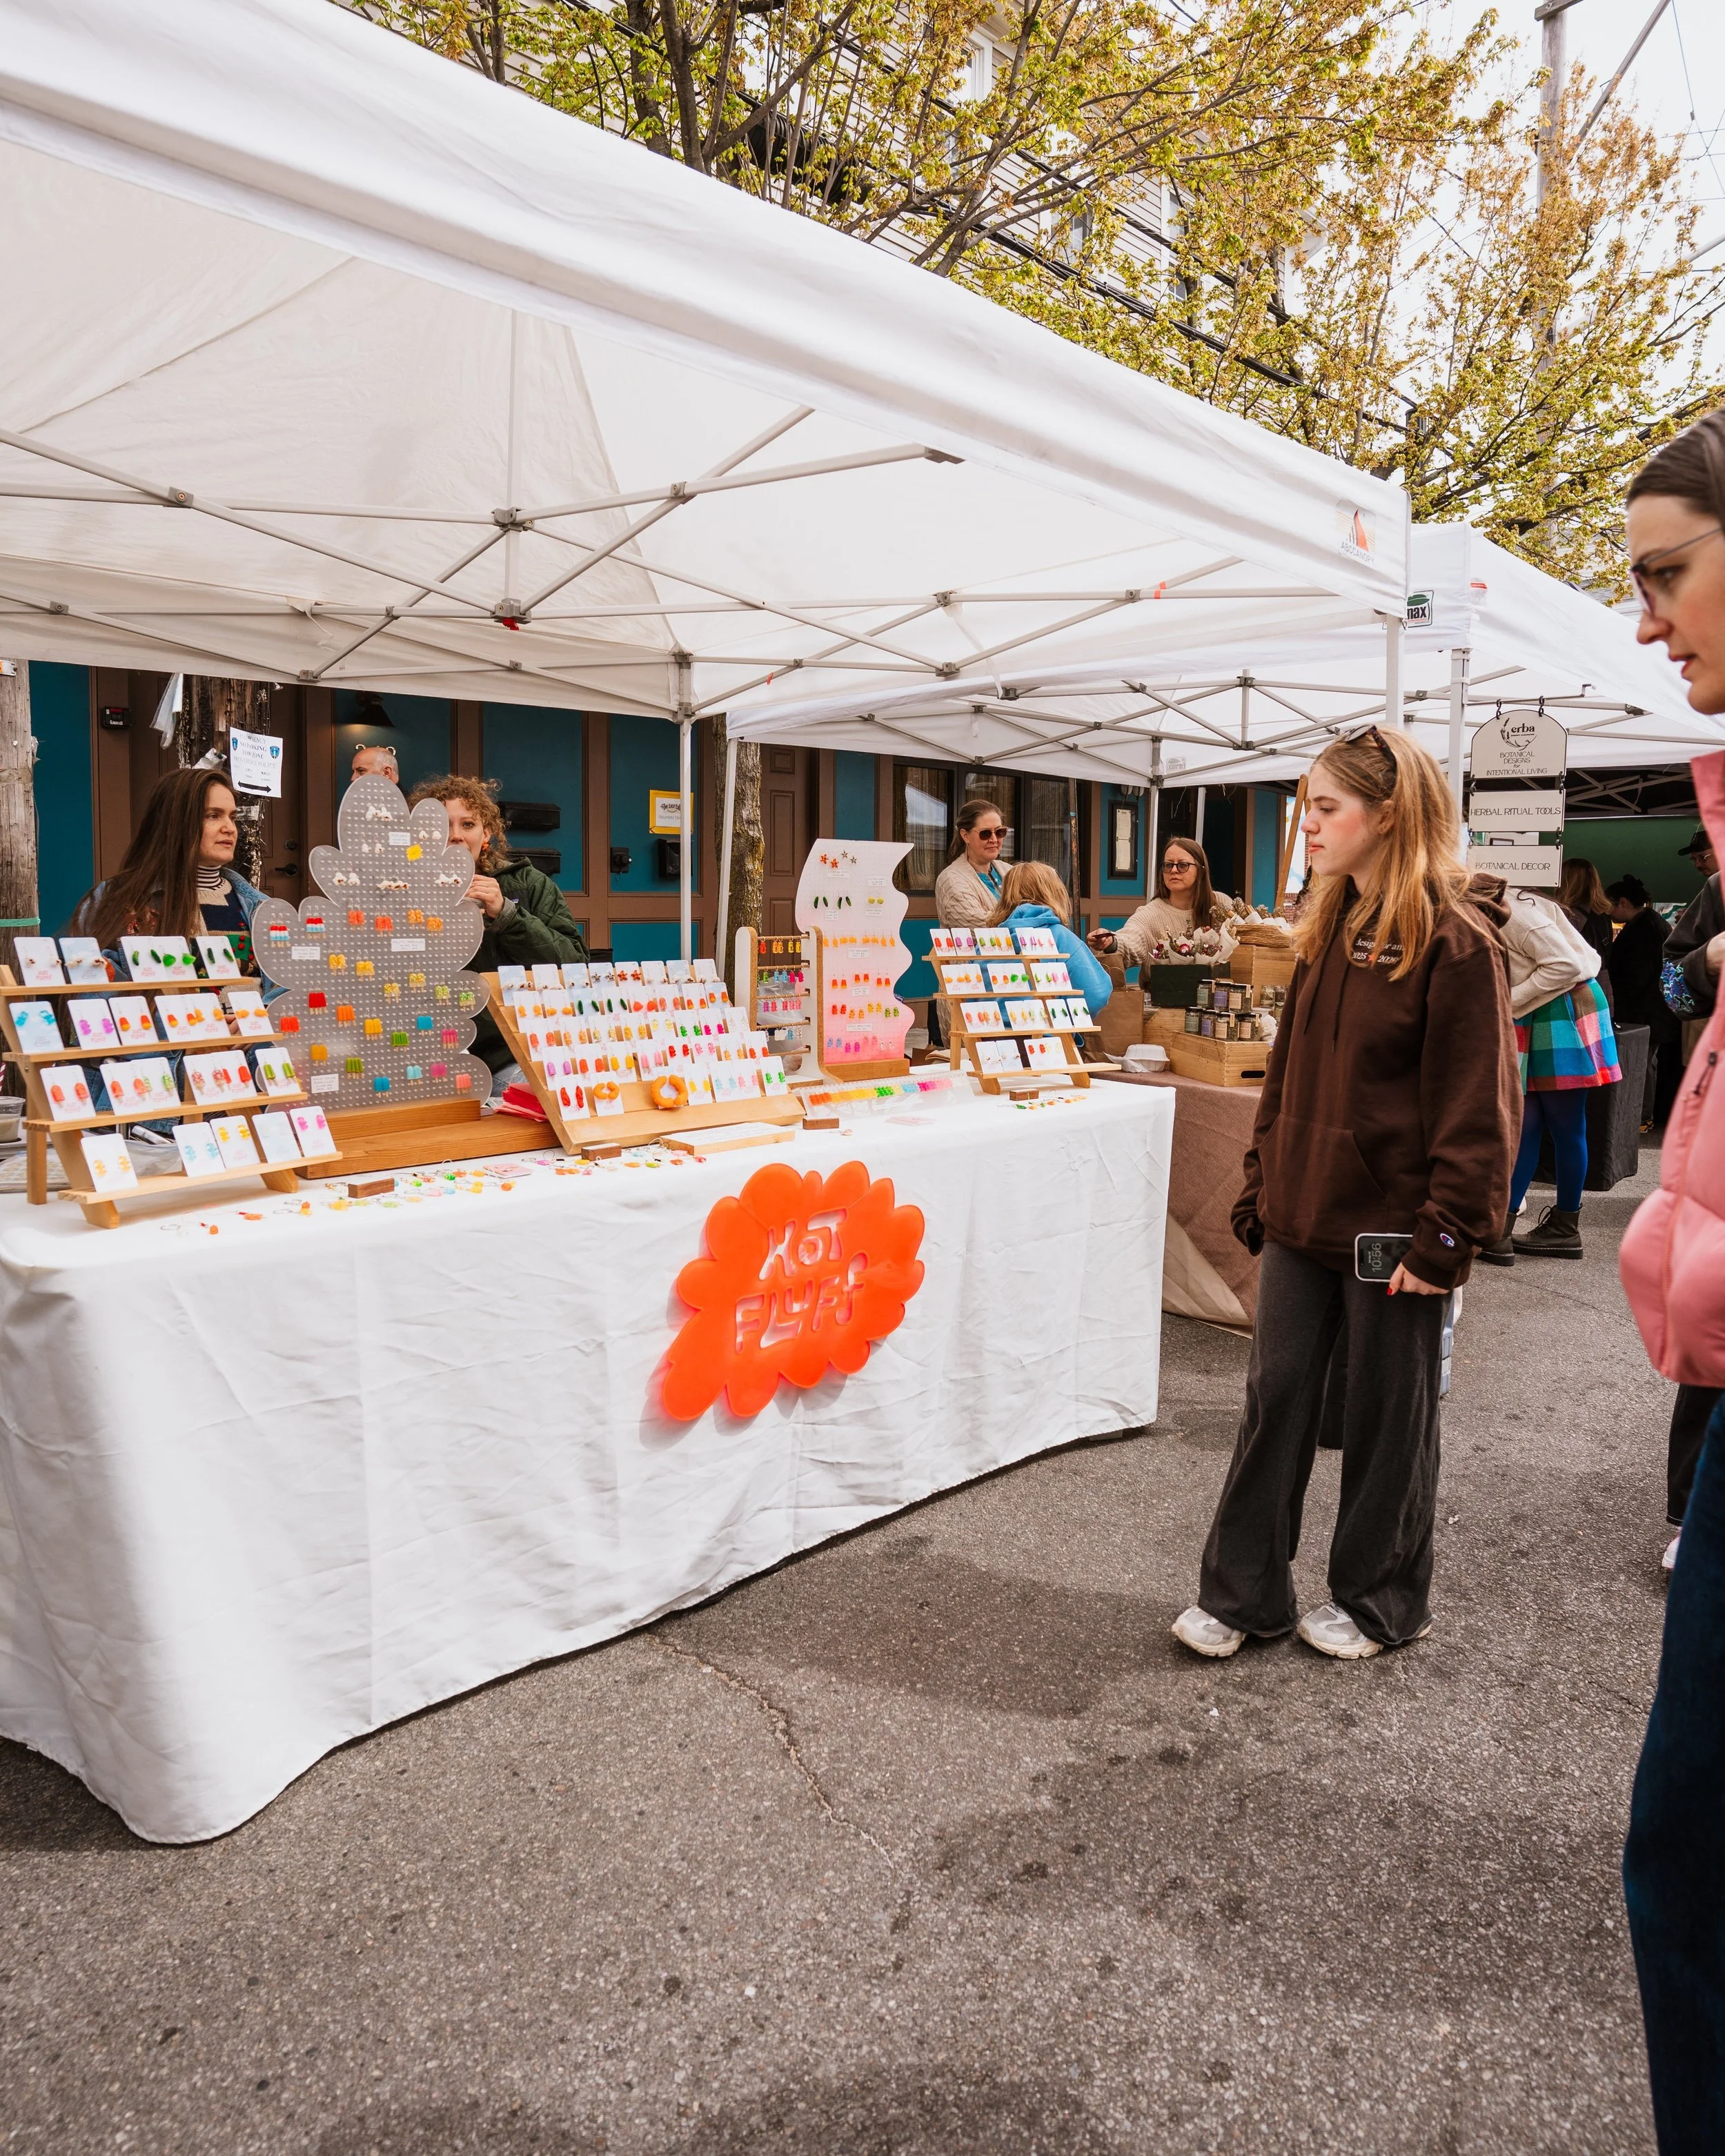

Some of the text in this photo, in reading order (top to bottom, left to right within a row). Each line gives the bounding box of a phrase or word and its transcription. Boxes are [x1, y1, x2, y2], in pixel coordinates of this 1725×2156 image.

[1341, 542, 1374, 564] ABCCANOPY
[1511, 723, 1535, 733] erba
[247, 742, 267, 752] PARKING
[1470, 807, 1561, 816] HERBAL RITUAL TOOLS
[1521, 862, 1550, 871] DECOR
[1355, 938, 1376, 949] desig
[759, 1208, 848, 1281] HOT
[1372, 1243, 1382, 1273] 10:56
